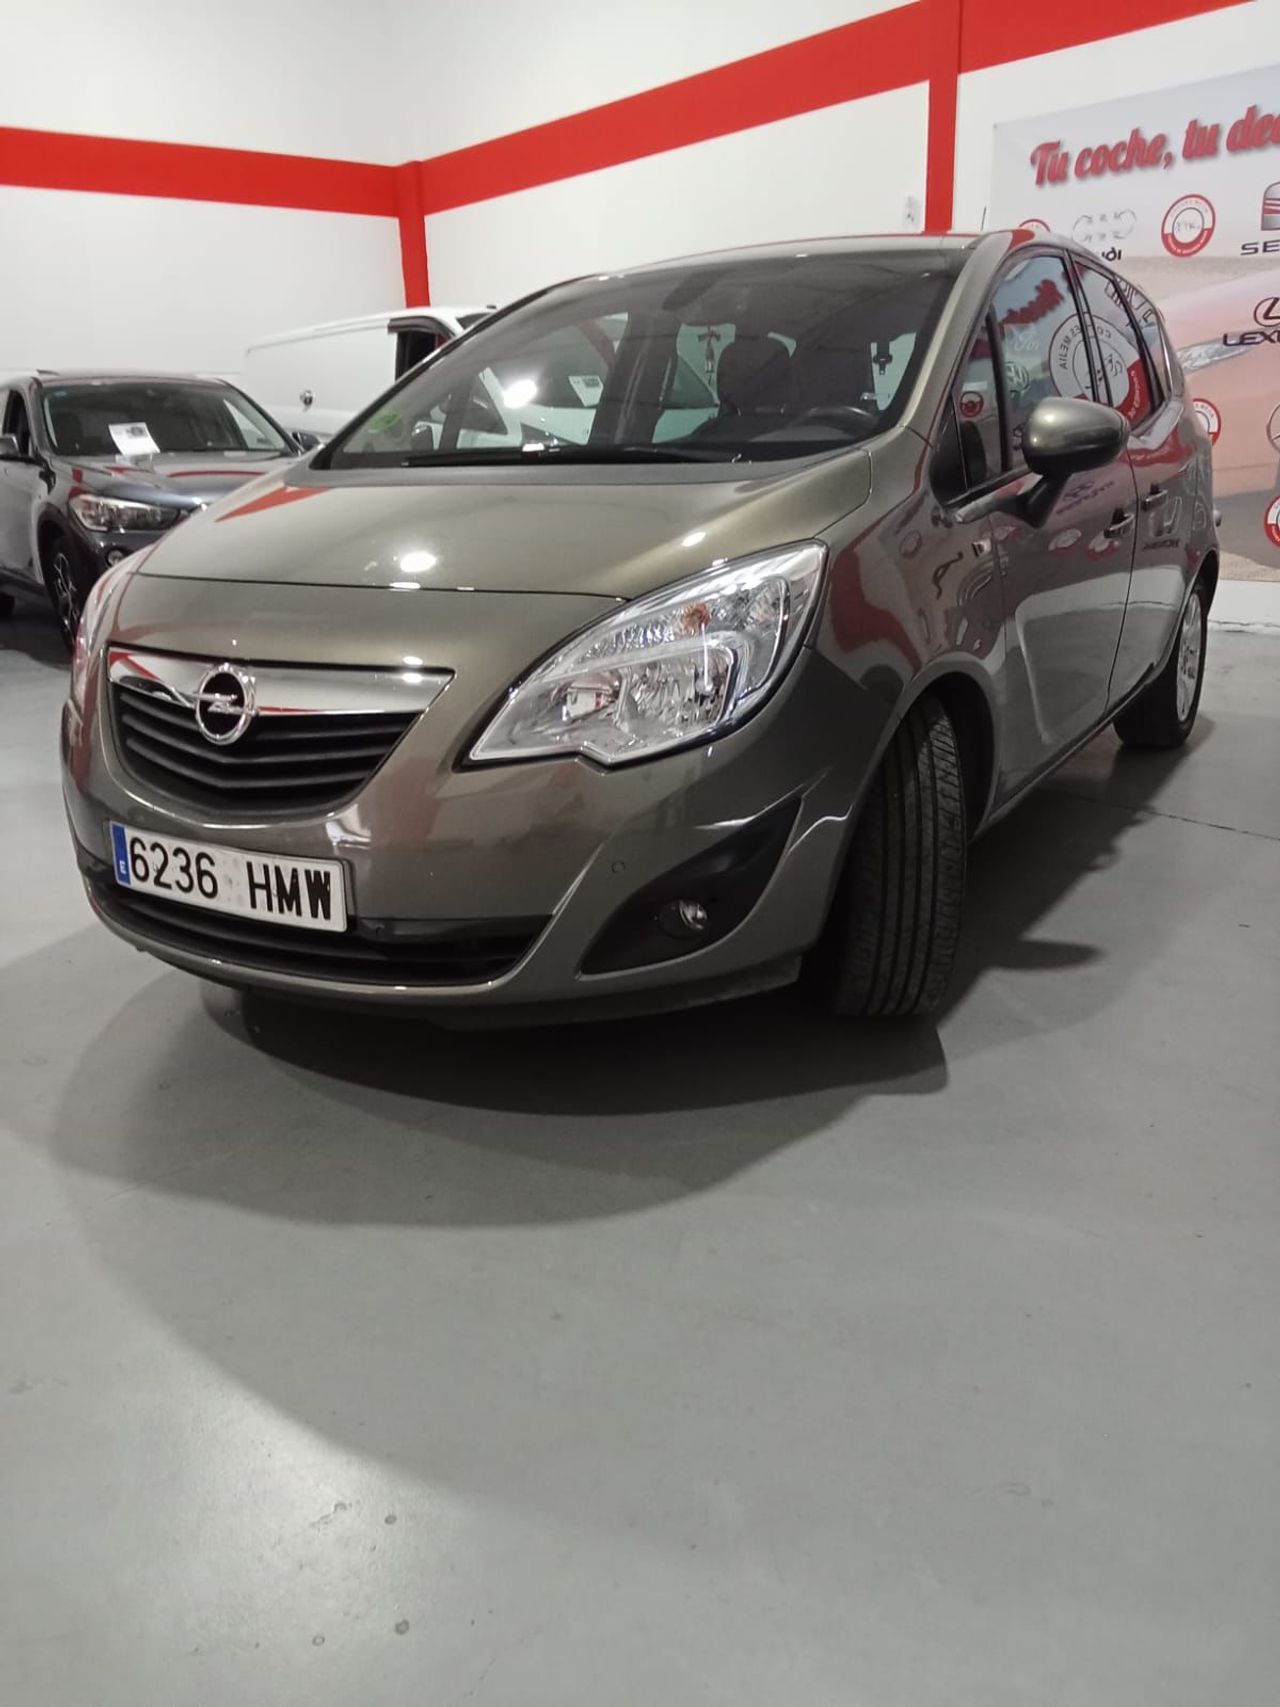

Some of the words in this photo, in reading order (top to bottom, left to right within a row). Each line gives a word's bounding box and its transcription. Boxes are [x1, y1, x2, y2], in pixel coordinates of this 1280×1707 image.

[1030, 140, 1069, 186] Tu
[1074, 127, 1173, 178] coche,
[1182, 119, 1220, 160] tu
[1222, 330, 1280, 347] LEX
[119, 859, 127, 875] E
[129, 836, 219, 899] 6236
[246, 861, 331, 920] HMW
